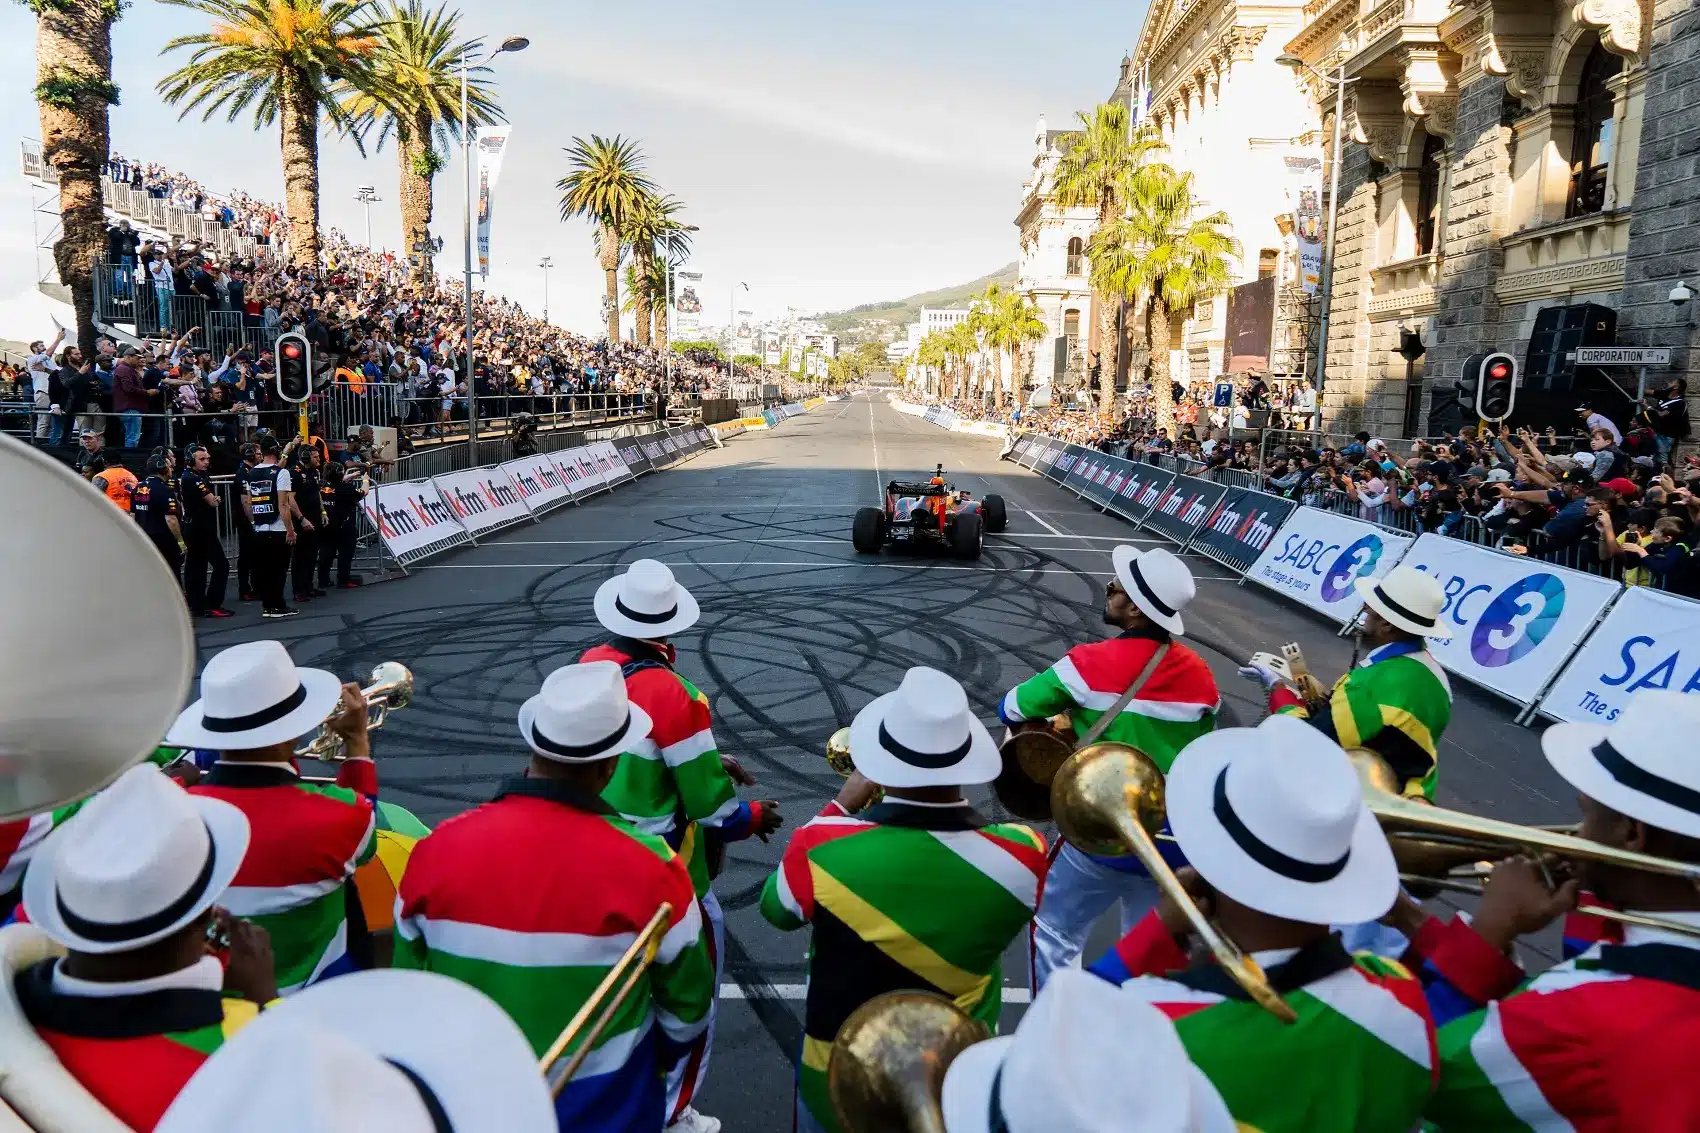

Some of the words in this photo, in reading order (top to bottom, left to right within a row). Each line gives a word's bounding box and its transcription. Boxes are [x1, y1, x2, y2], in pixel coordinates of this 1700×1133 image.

[1582, 350, 1643, 361] CORPORATION
[1219, 384, 1229, 394] P
[510, 472, 541, 499] kfm
[532, 465, 561, 490] kfm
[554, 461, 581, 485] kfm
[573, 457, 598, 478] kfm
[1116, 470, 1140, 500] kfm
[1134, 479, 1160, 508] kfm
[366, 502, 418, 539] kfm
[408, 494, 450, 527] kfm
[443, 486, 487, 519] kfm
[478, 479, 518, 508] kfm
[1155, 485, 1184, 516] kfm
[1176, 492, 1206, 526] kfm
[1205, 499, 1240, 535] kfm
[1234, 508, 1273, 551] kfm
[1273, 533, 1340, 576] SABC
[1261, 565, 1272, 576] The
[1271, 571, 1288, 584] stage
[1285, 574, 1292, 585] is
[1289, 579, 1311, 592] yours
[1578, 691, 1608, 715] The
